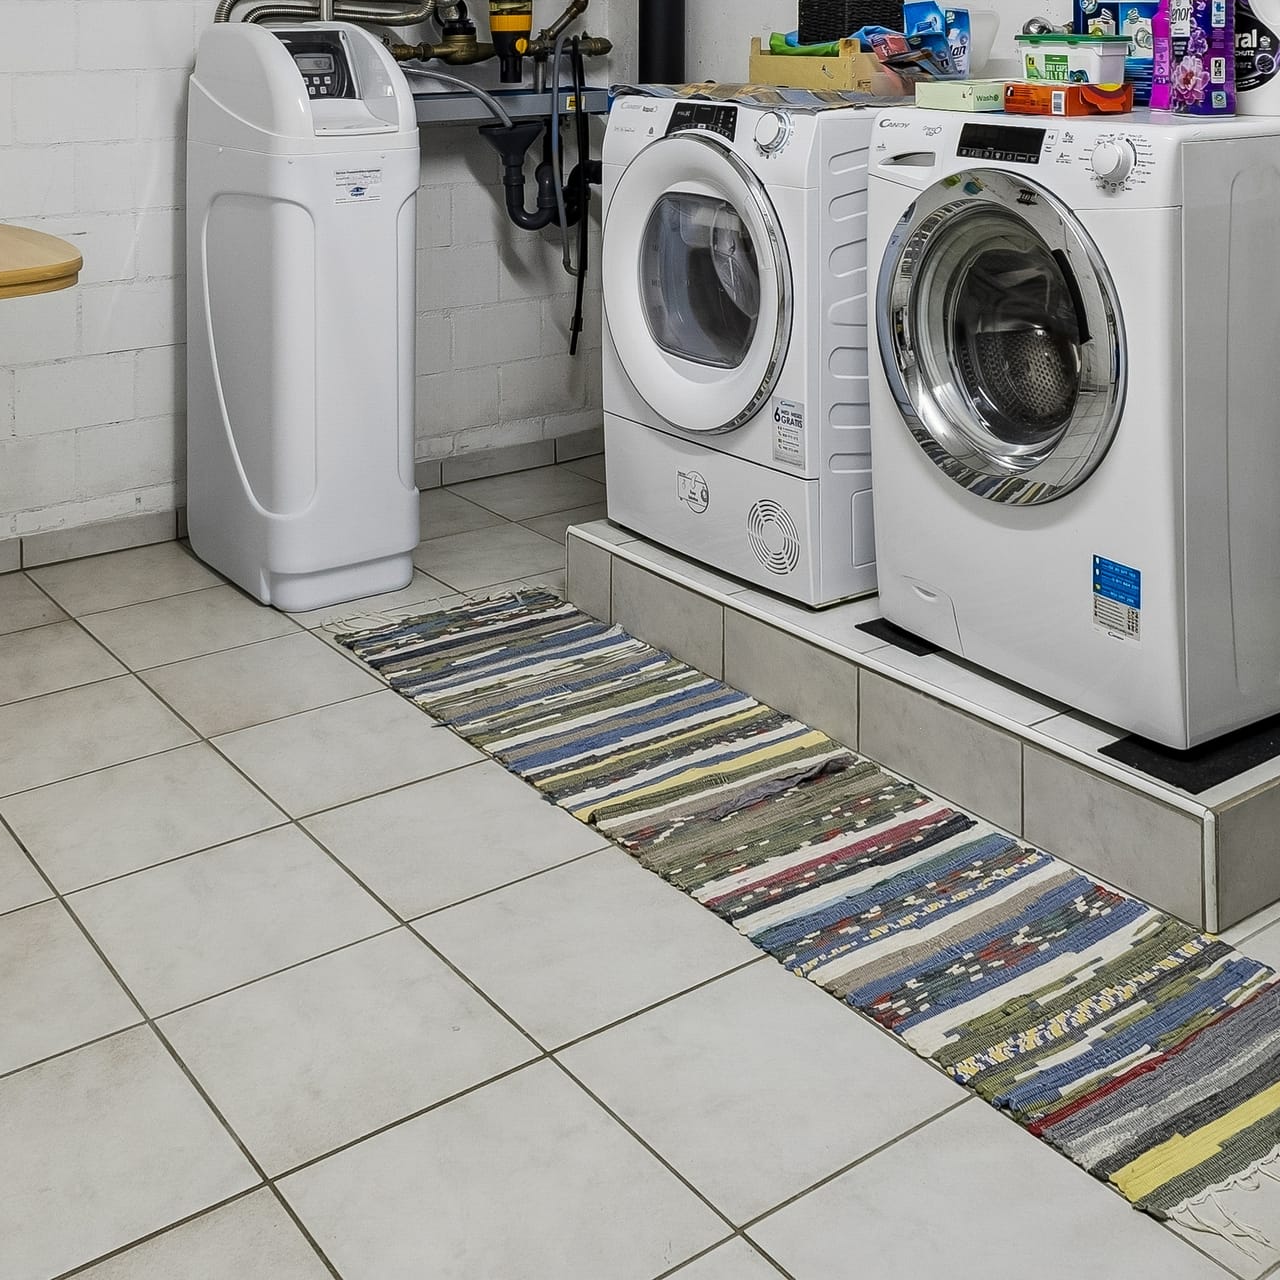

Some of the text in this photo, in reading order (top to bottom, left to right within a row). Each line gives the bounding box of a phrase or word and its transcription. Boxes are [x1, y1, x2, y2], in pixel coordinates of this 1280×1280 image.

[1171, 7, 1192, 24] enor
[1235, 28, 1258, 48] ral
[951, 43, 968, 58] lan
[1046, 71, 1067, 81] ULTRA
[774, 407, 780, 422] 6
[781, 415, 802, 428] GRATIS
